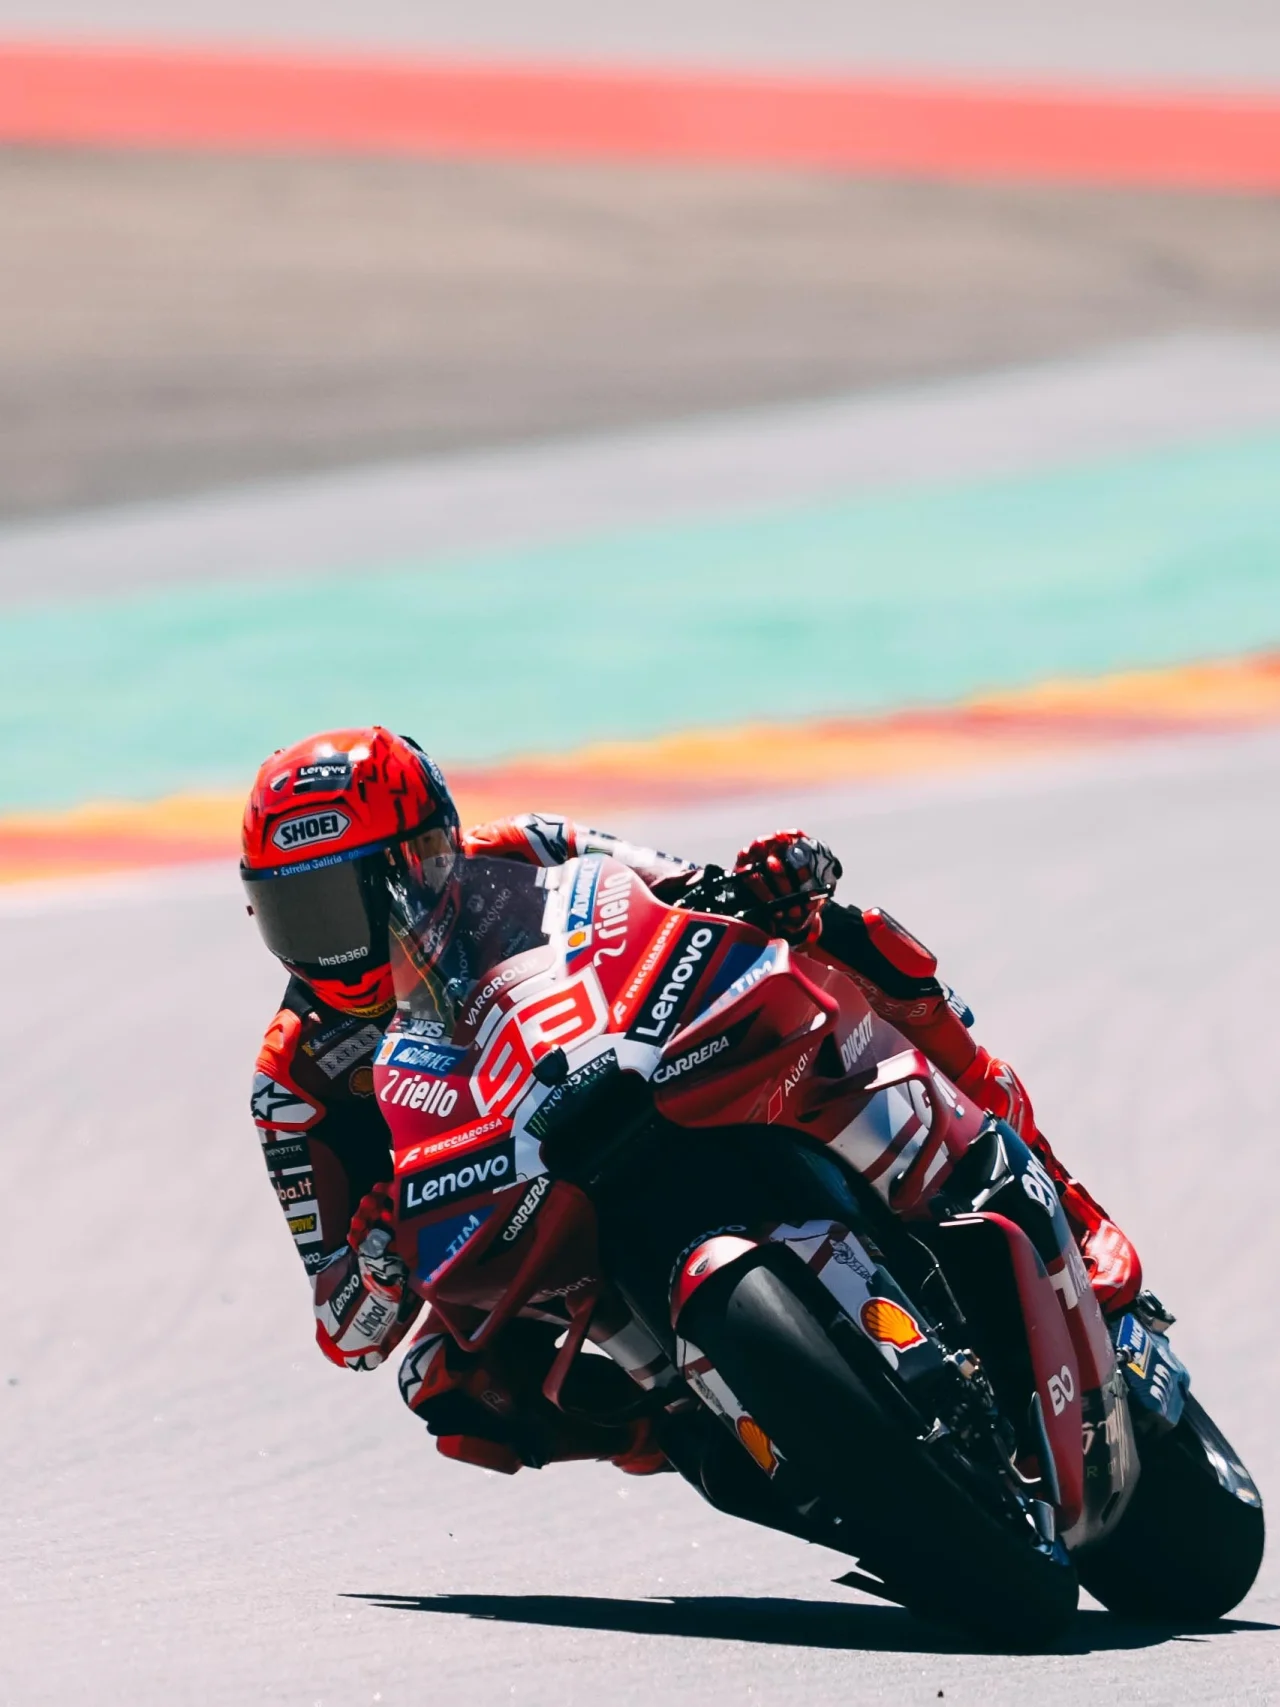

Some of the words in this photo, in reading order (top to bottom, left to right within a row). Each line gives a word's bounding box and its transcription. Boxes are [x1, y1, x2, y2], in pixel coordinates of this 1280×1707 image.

[281, 815, 339, 846] SHOEI
[281, 862, 311, 876] Estrella
[312, 855, 343, 869] Galicia
[594, 871, 635, 939] riello
[318, 946, 369, 966] Insta360
[626, 913, 681, 999] FRECCIAROSSA
[636, 928, 713, 1038] Lenovo
[728, 960, 774, 997] TIM
[393, 1046, 456, 1072] ADVANCE
[653, 1036, 730, 1085] CARRERA
[840, 1011, 874, 1073] DUCATI
[391, 1074, 458, 1118] riello
[542, 1051, 617, 1115] MONSTER
[784, 1052, 809, 1098] Audi
[423, 1118, 504, 1156] FRECCIAROSSA
[276, 1177, 313, 1201] ba.it
[407, 1155, 510, 1209] Lenovo
[502, 1176, 550, 1241] CARRERA
[446, 1214, 480, 1257] TIM
[331, 1274, 360, 1316] Lenovo
[353, 1295, 389, 1337] Unipol
